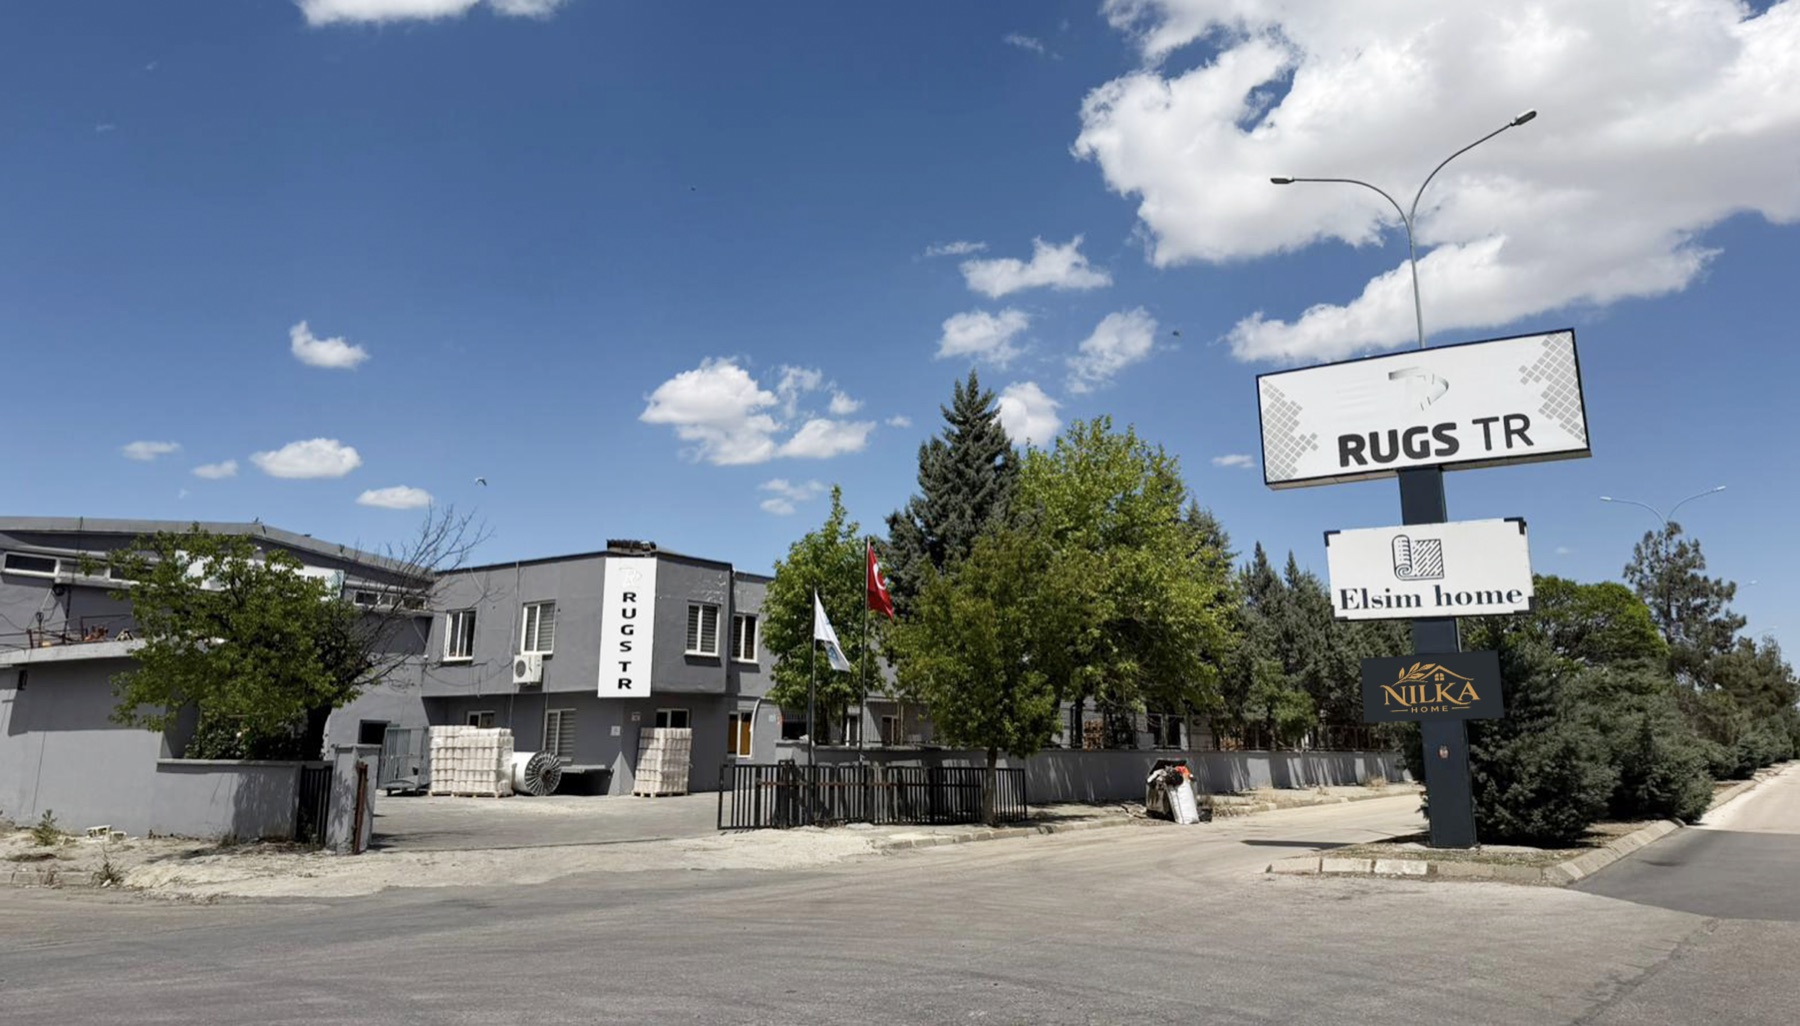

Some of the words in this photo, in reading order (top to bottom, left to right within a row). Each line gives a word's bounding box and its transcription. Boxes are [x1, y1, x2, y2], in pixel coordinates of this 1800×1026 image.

[1338, 422, 1460, 467] RUGS
[1472, 413, 1534, 451] TR
[1339, 588, 1422, 611] Elsim
[1433, 584, 1524, 607] home
[620, 592, 637, 652] RUGS
[617, 661, 632, 690] TR
[1380, 681, 1480, 707] NILKA
[1411, 705, 1449, 713] HOME
